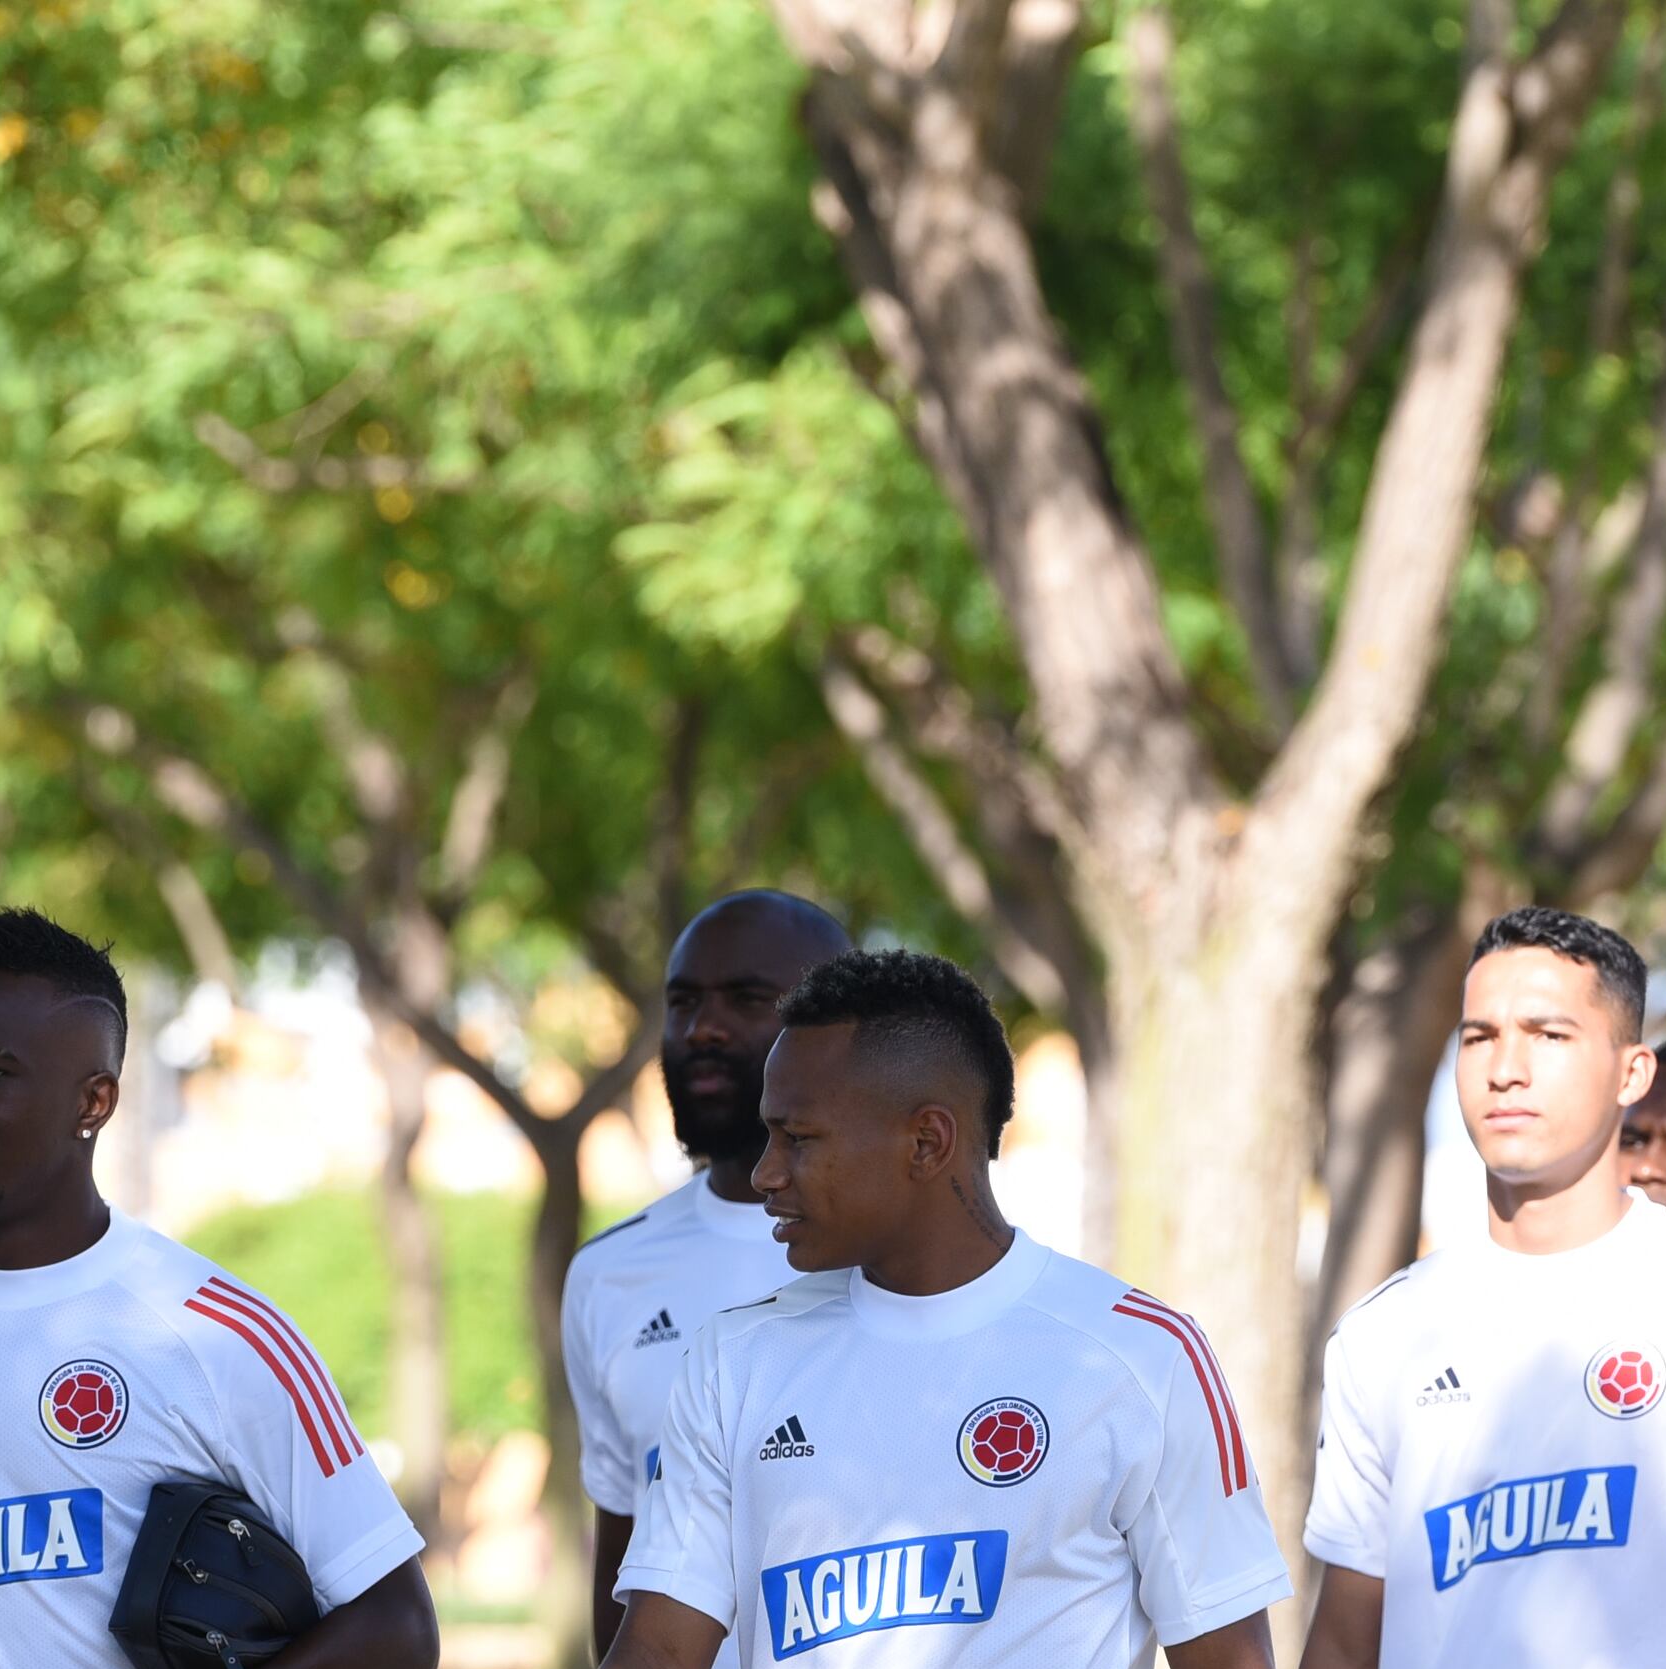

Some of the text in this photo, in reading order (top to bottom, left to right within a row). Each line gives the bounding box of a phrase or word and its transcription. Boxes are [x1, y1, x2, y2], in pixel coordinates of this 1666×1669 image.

[759, 1440, 815, 1461] adidas
[1443, 1472, 1614, 1583] AGUILA
[781, 1539, 984, 1653] AGUILA
